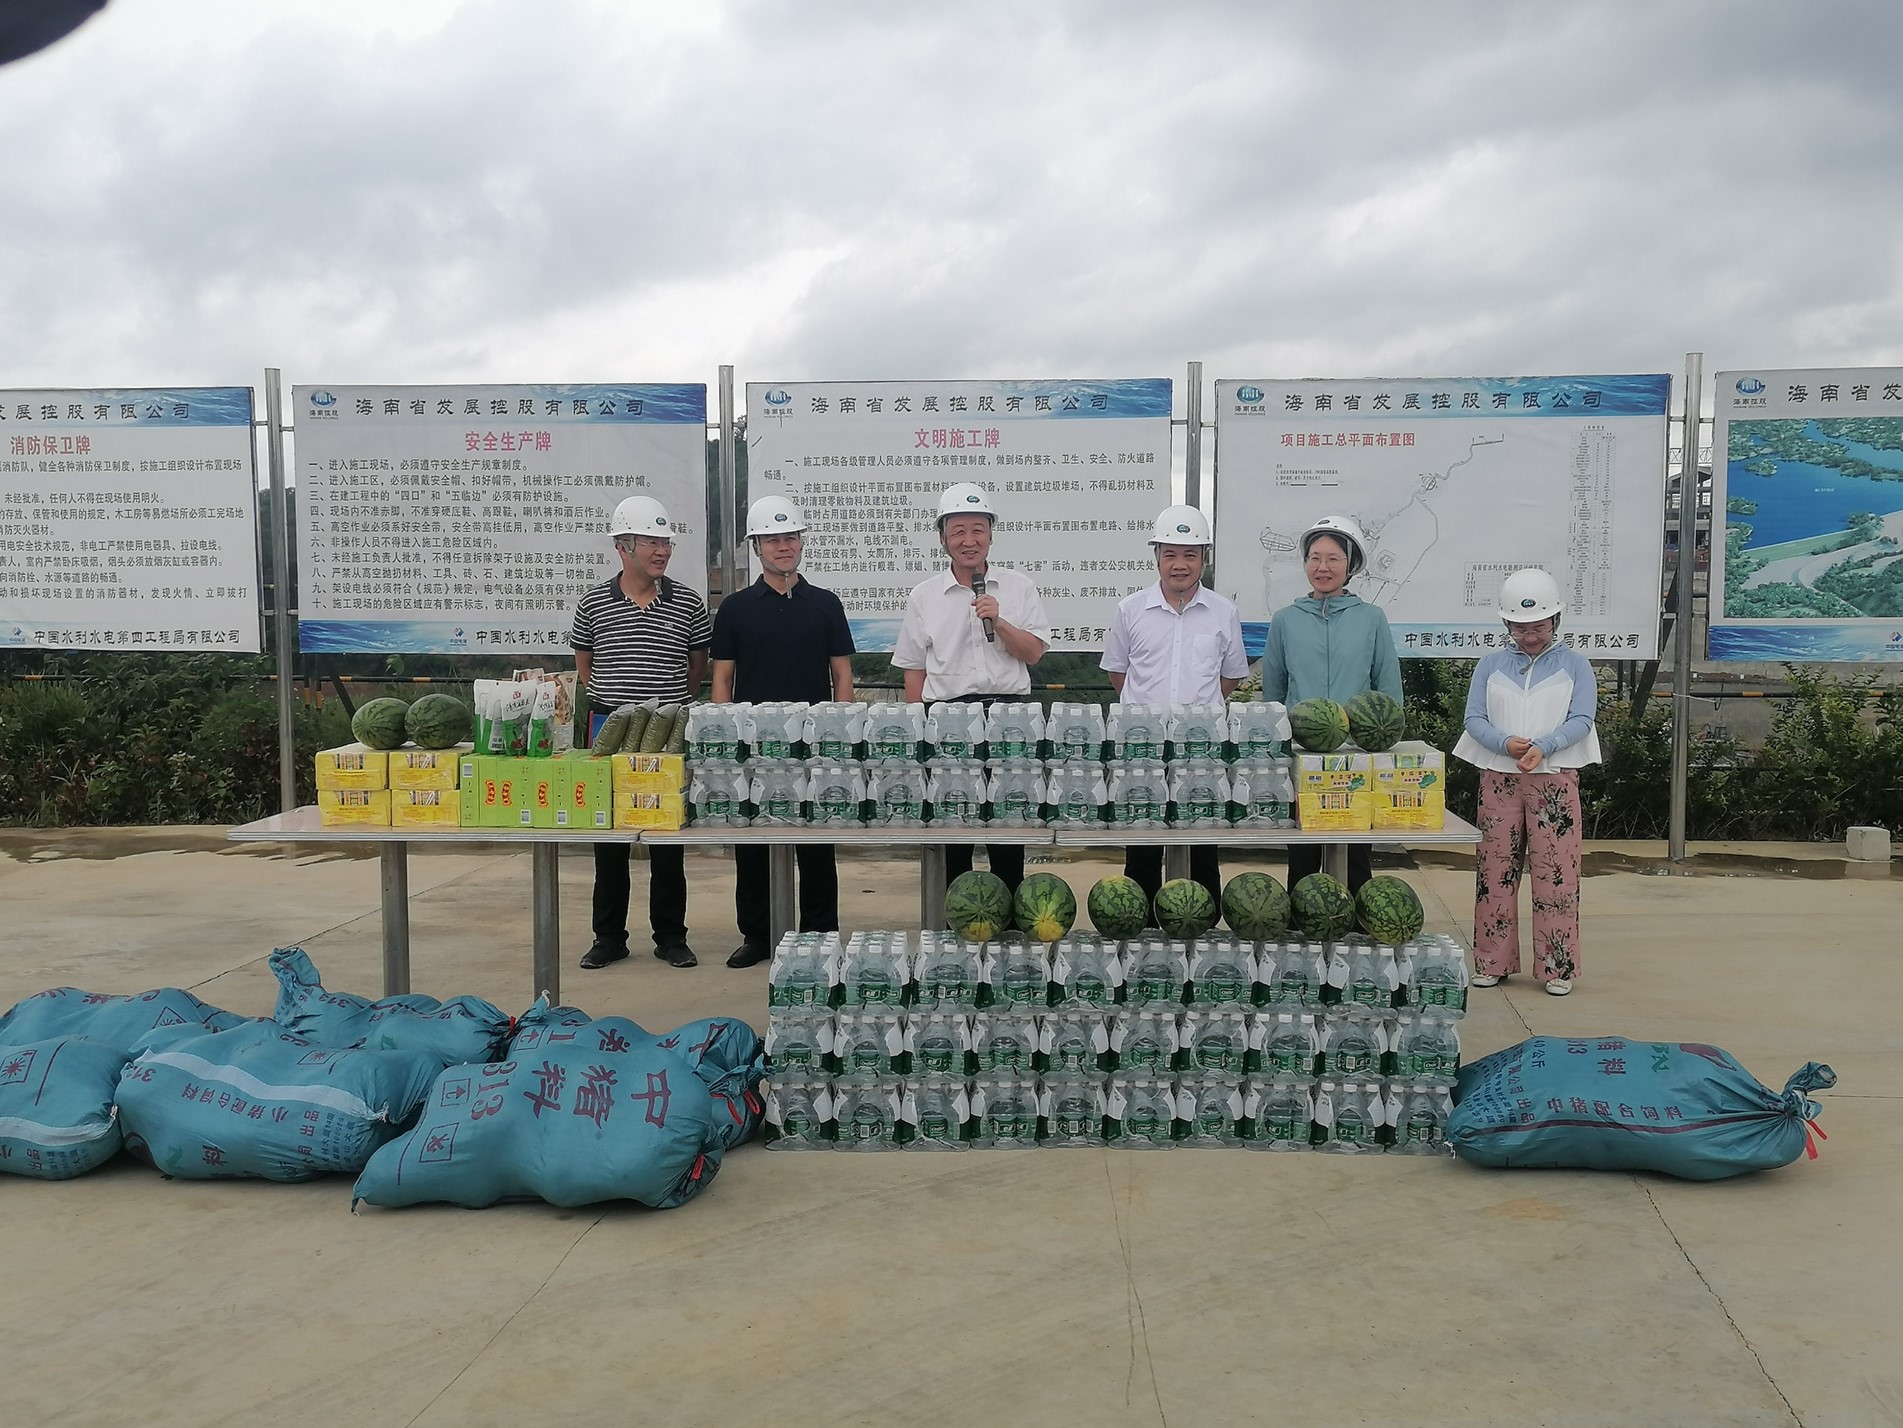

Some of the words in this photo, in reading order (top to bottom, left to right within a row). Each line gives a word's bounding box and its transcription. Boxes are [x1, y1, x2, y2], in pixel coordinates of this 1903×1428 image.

[1285, 391, 1603, 411] 海南省发展控股有限公司
[1788, 383, 1903, 402] 海南省发
[355, 398, 644, 416] 海南省发展控股有限公司
[811, 394, 1108, 413] 海南省发展控股有限公司
[11, 436, 91, 455] 消防保卫牌
[465, 430, 552, 451] 安全生产牌
[914, 427, 1000, 449] 文明施工牌
[1281, 433, 1415, 447] 项目施工总平面布置图
[0, 459, 242, 473] 消防队，健全各种消防保卫制度，按施工组织设计布置现场
[34, 630, 240, 645] 中国水利水电第四工程局有限公司
[182, 1082, 290, 1123] 小猪配合饲料
[1547, 1096, 1684, 1121] 中猪配合饲料
